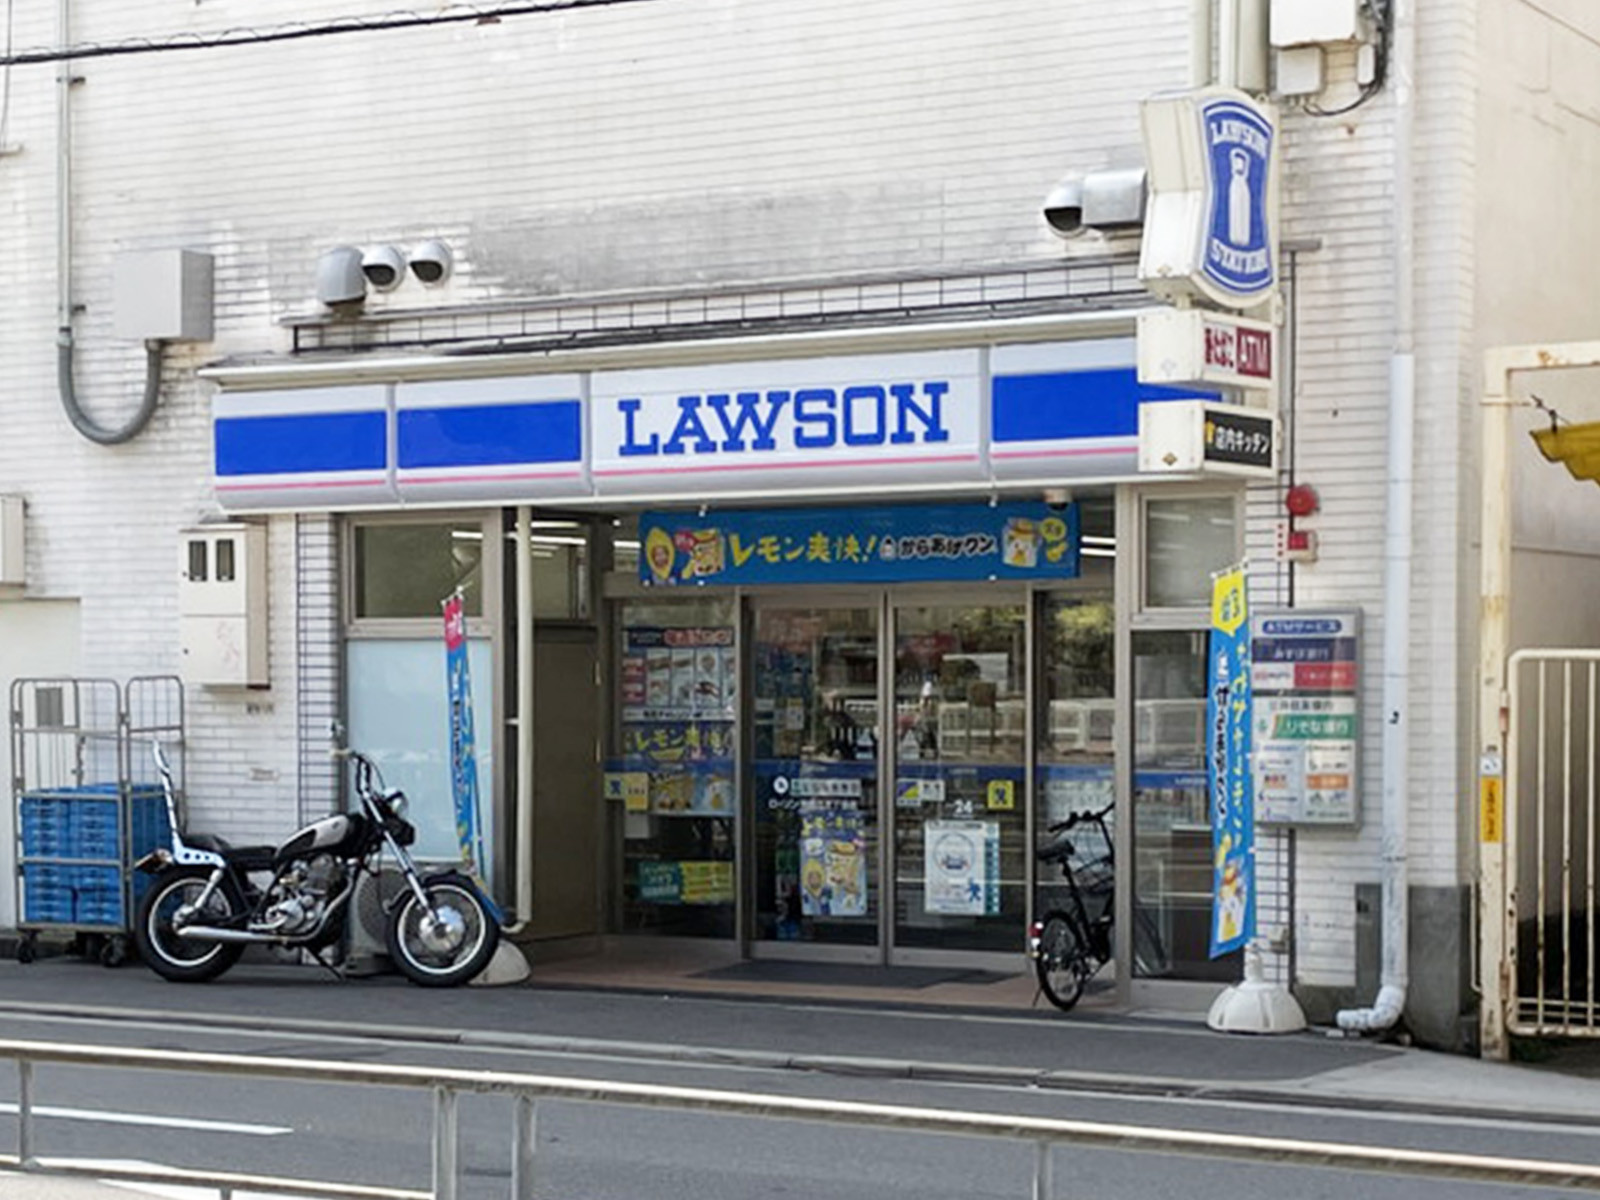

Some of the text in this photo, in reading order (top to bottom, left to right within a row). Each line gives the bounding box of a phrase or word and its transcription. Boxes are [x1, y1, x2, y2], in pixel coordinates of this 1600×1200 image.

[1210, 119, 1268, 160] LAWSON
[1240, 334, 1269, 374] ATM
[618, 382, 949, 457] LAWSON
[1215, 424, 1271, 456] 店内キッチン
[899, 535, 996, 560] からあげクン
